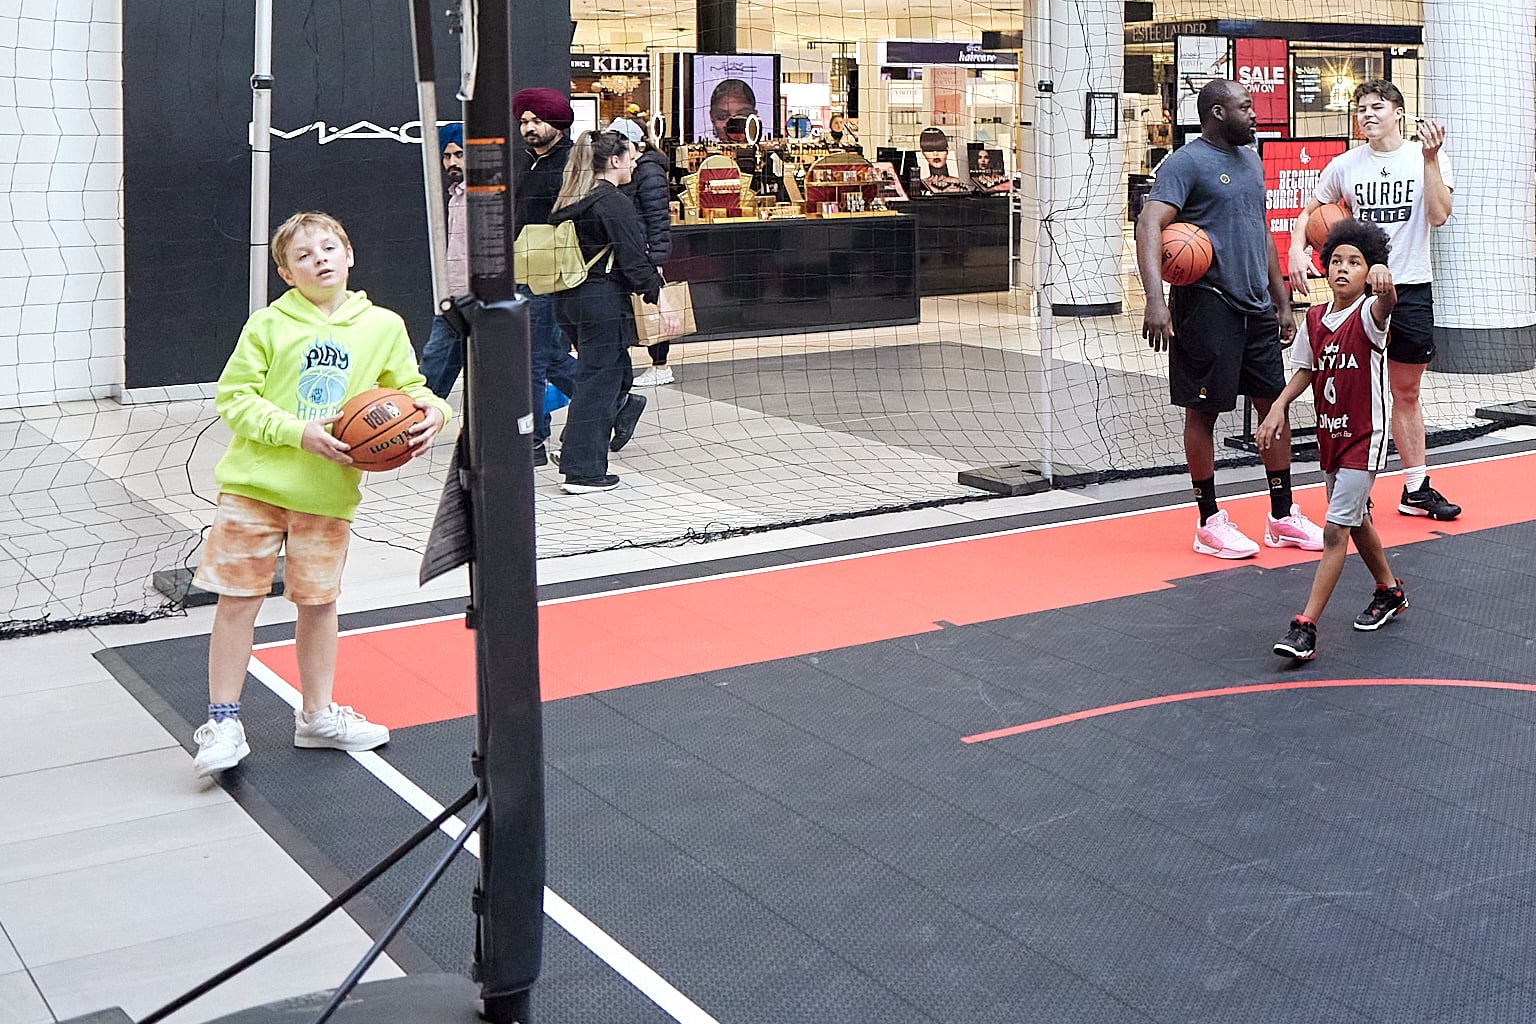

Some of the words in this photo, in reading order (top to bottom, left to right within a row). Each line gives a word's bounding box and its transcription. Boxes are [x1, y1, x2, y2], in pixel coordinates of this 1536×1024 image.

[592, 56, 649, 72] KIEH
[1238, 66, 1285, 85] SALE
[1261, 84, 1275, 93] ON
[1265, 189, 1299, 210] SURGE
[1354, 179, 1415, 206] SURGE
[1270, 218, 1289, 233] SCAN
[1361, 209, 1406, 222] ELITE
[307, 344, 349, 370] PLAY
[1324, 376, 1337, 405] 6
[362, 405, 395, 429] NBA
[369, 421, 418, 455] ilson
